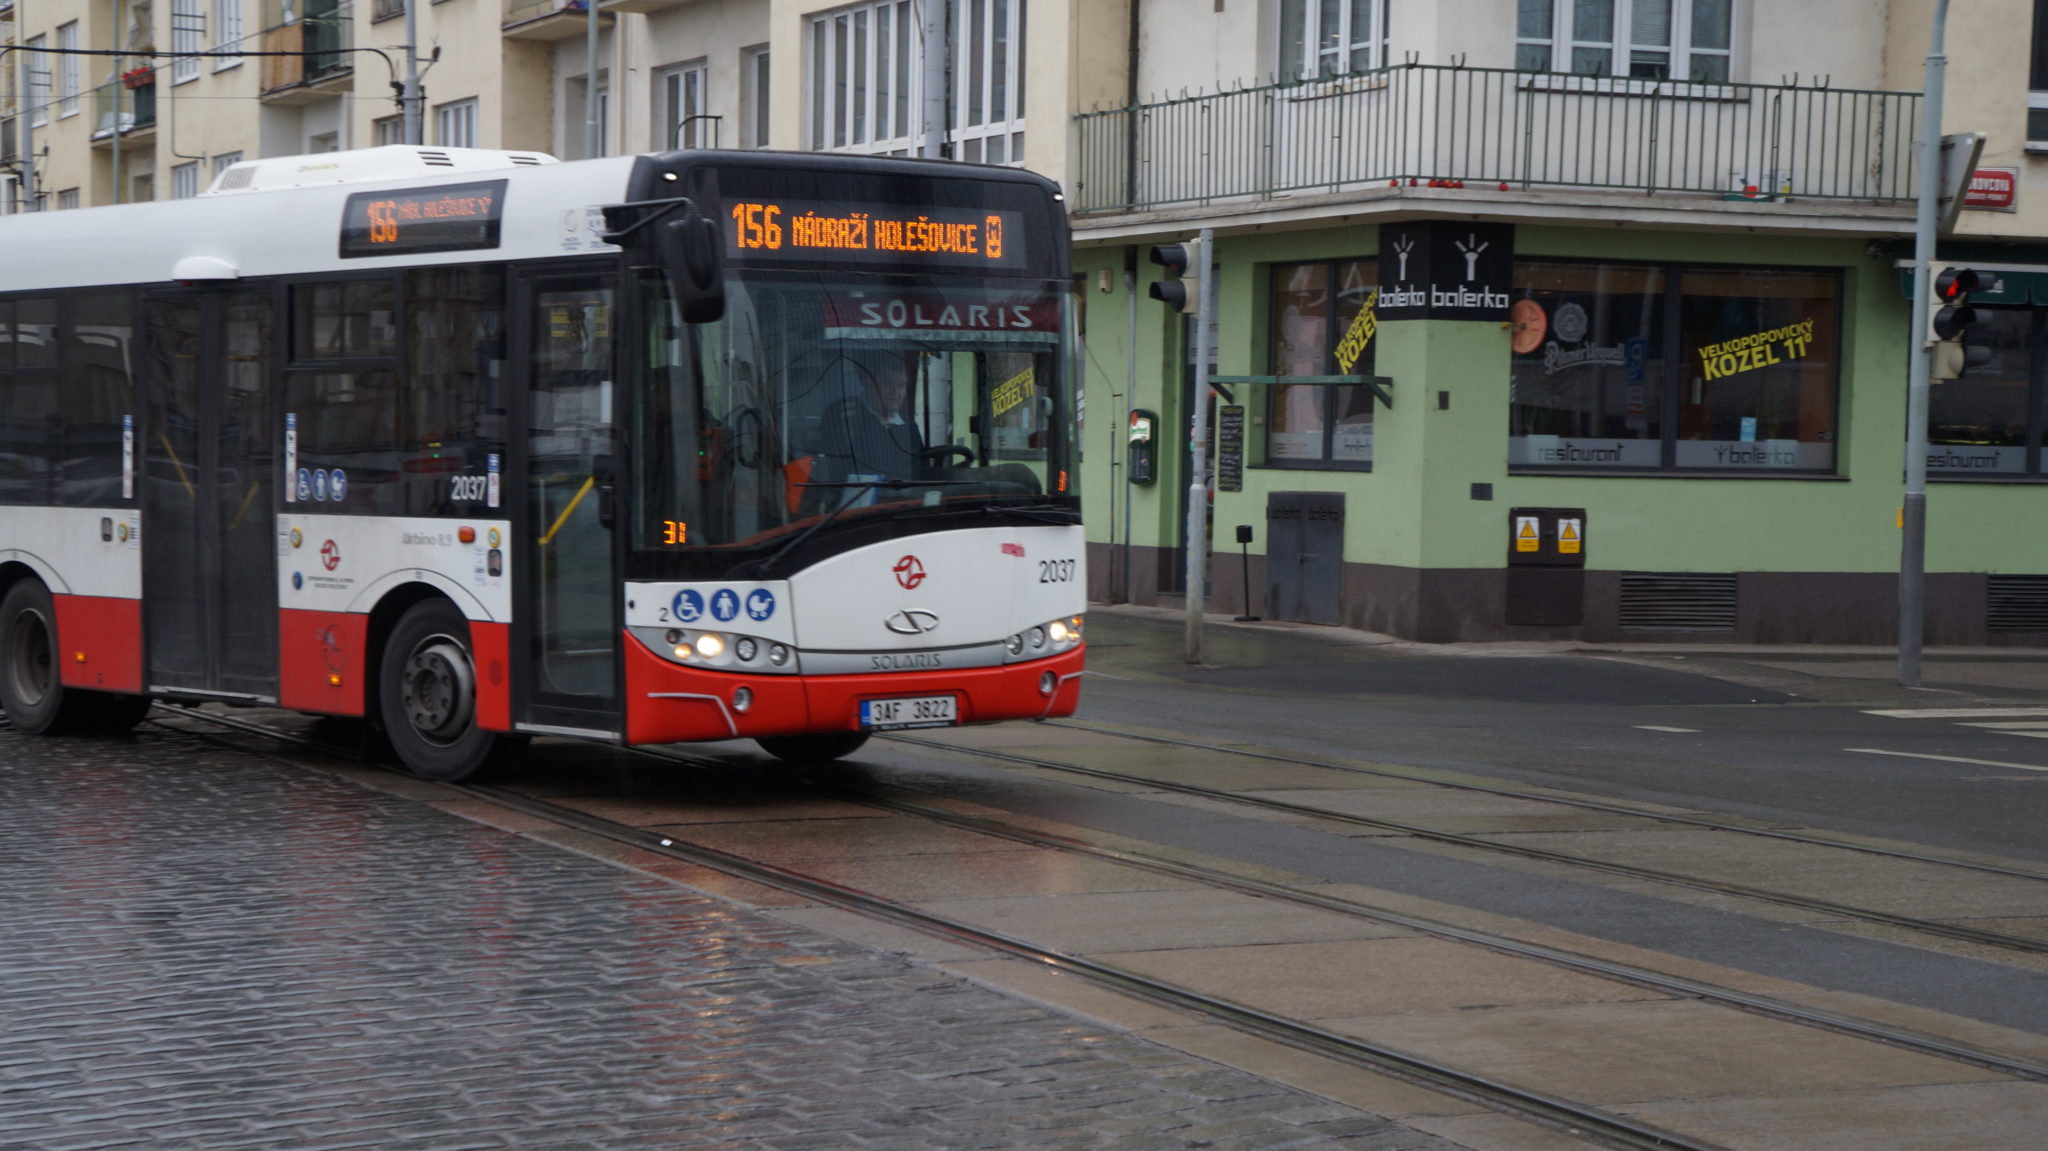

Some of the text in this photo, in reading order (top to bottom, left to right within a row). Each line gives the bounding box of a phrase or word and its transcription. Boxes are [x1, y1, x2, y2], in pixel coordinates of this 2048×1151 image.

[367, 200, 399, 243] 156
[732, 203, 978, 253] 156 NÁDRAŽÍ HOLEŠOVICE
[1431, 284, 1510, 309] baterka
[860, 299, 1033, 328] SOLARIS
[1703, 343, 1781, 381] KOZEL
[1538, 441, 1625, 462] restaurant
[1926, 448, 2001, 469] estaurant
[451, 475, 487, 501] 2037
[663, 520, 687, 545] 31
[1039, 558, 1076, 583] 2037
[658, 606, 669, 622] 2
[871, 652, 943, 671] SOLARIS
[874, 699, 950, 722] 3AF 3822
